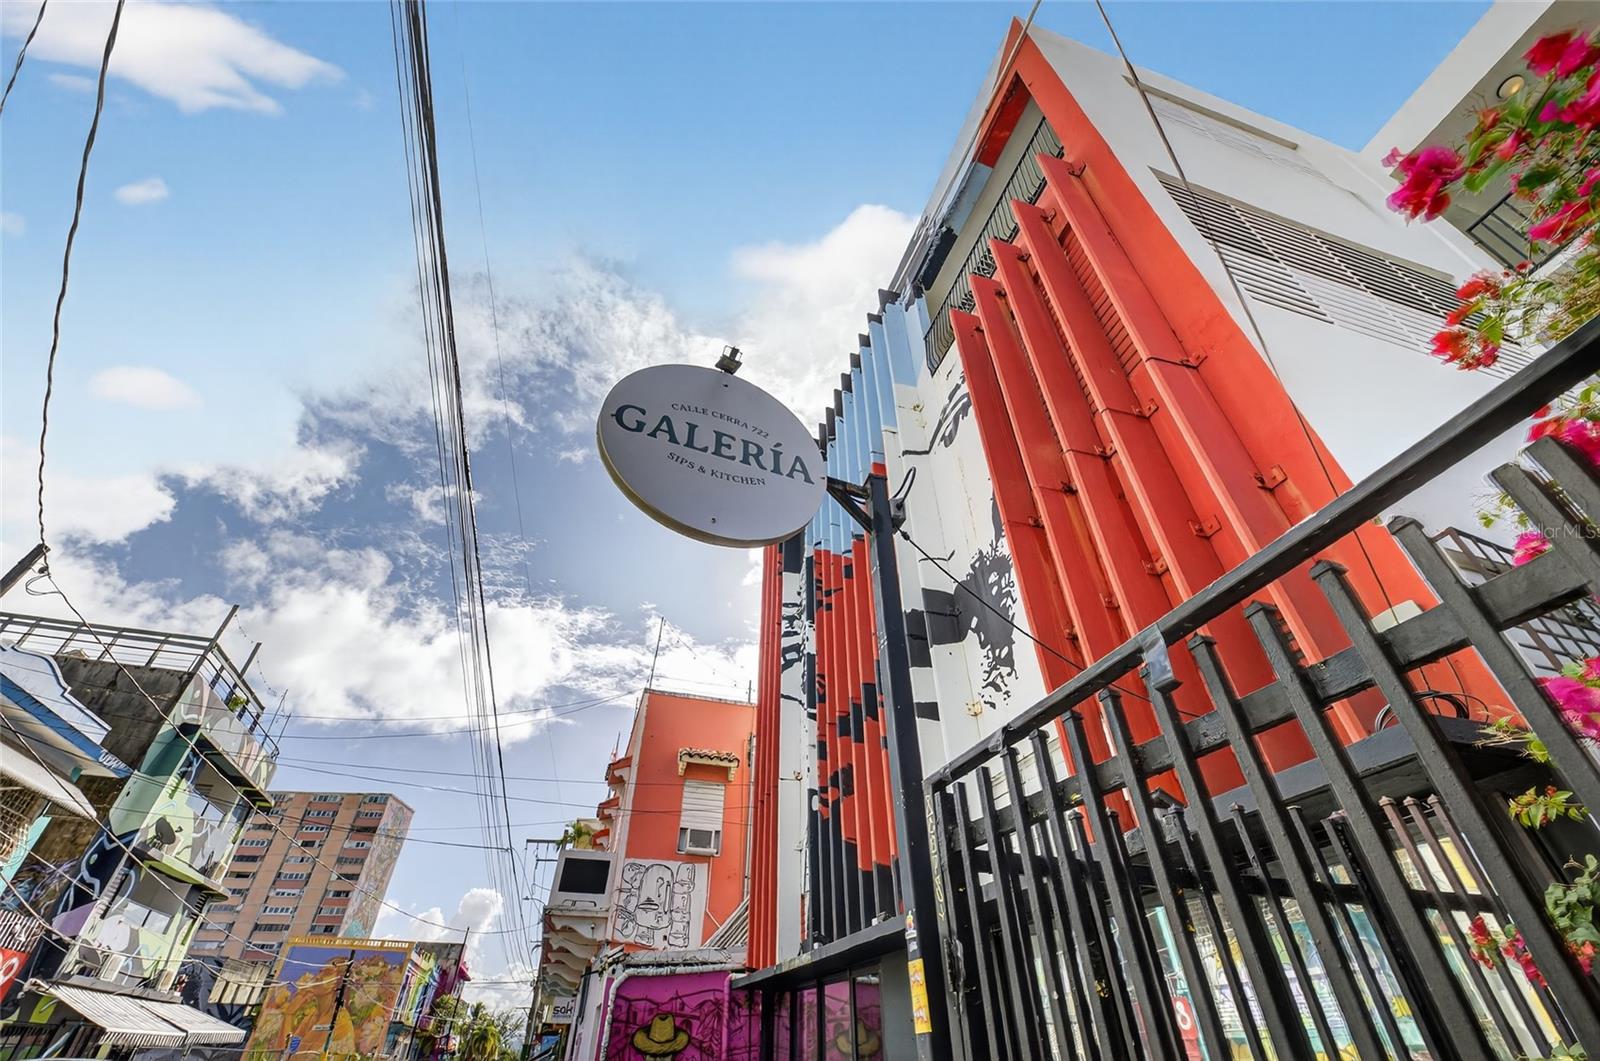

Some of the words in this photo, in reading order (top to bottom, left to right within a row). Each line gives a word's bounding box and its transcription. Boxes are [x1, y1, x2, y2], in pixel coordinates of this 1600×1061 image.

[671, 403, 709, 415] CALLE
[711, 411, 748, 429] CERRA
[751, 425, 769, 439] 722
[611, 404, 815, 485] GALERÍA
[667, 451, 696, 470] SIPS
[697, 465, 706, 474] &
[710, 469, 766, 486] KITCHEN
